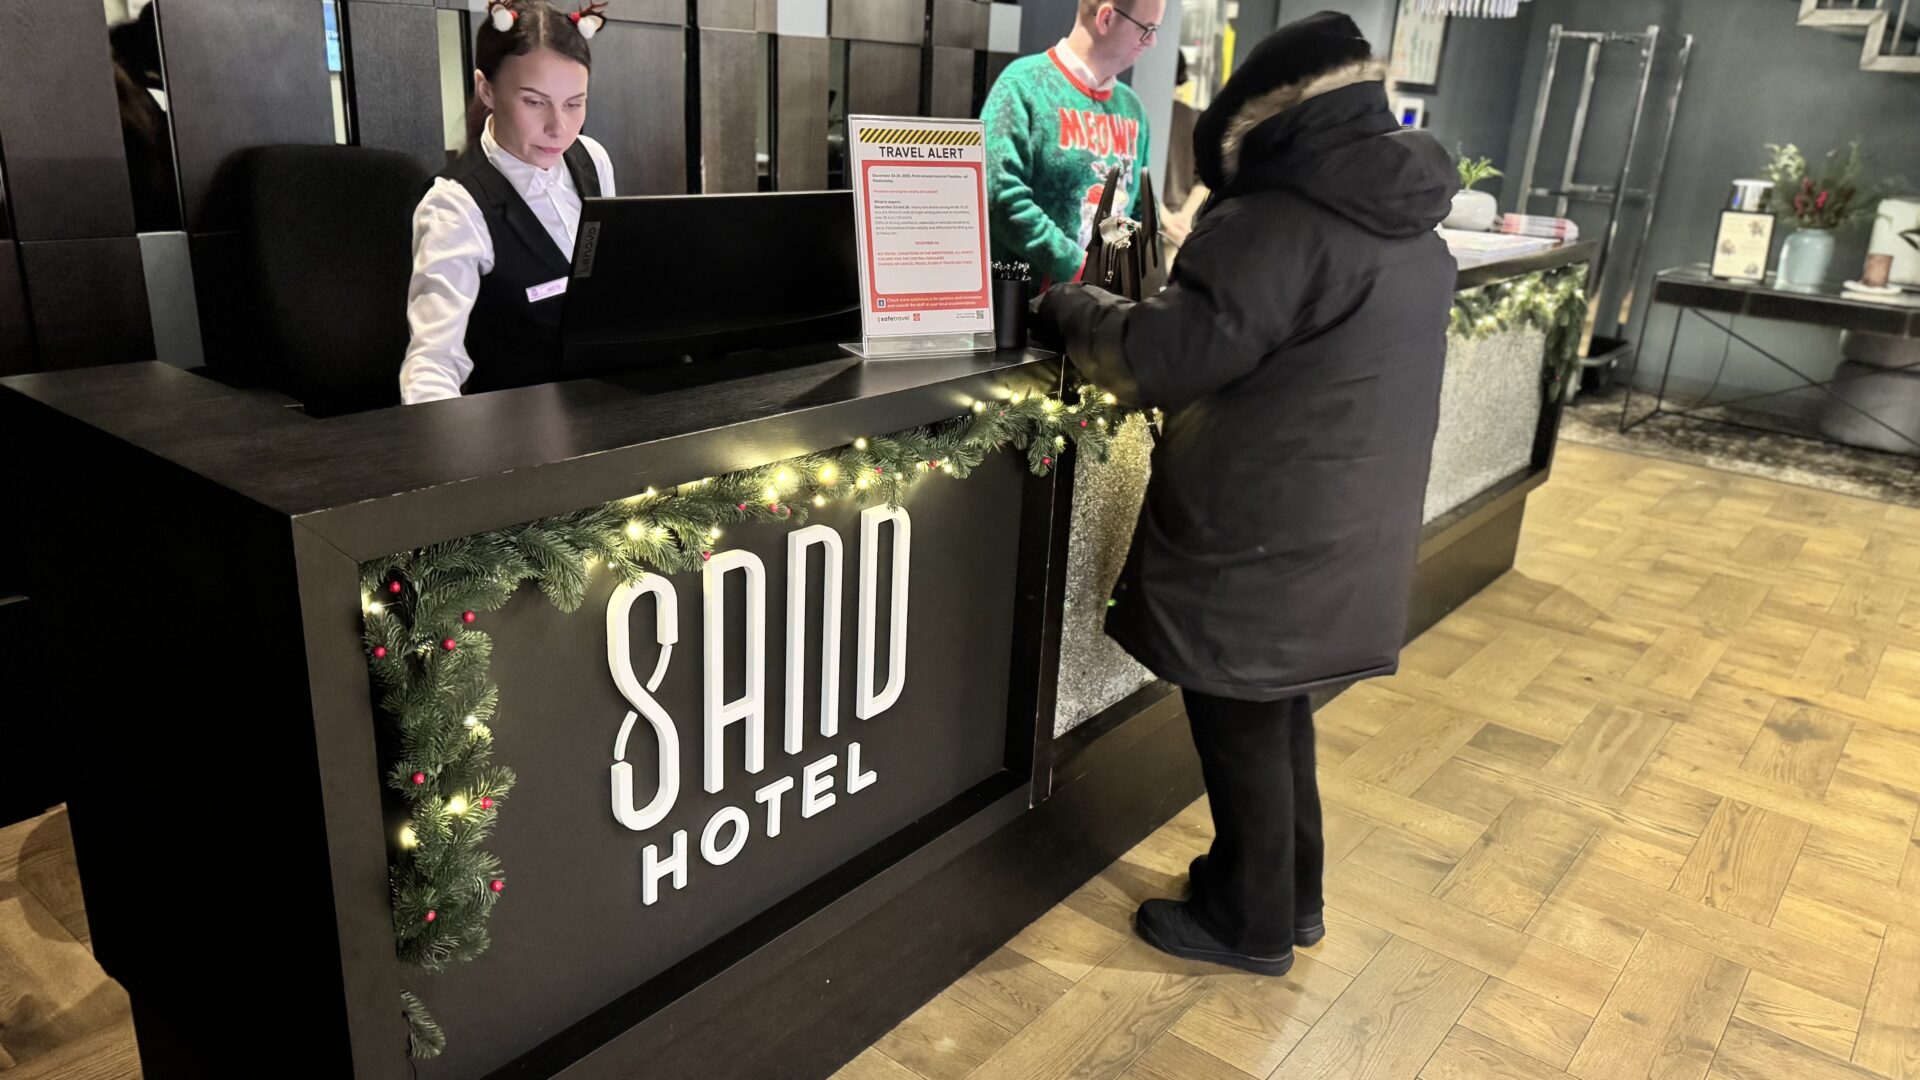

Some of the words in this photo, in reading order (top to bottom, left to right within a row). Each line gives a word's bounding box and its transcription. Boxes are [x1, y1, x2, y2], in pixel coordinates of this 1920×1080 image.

[879, 146, 925, 158] TRAVEL
[928, 147, 964, 159] ALERT
[1058, 107, 1139, 160] MEOWY
[581, 226, 597, 273] Lenovo
[606, 502, 912, 831] SAND
[642, 741, 878, 906] HOTEL
